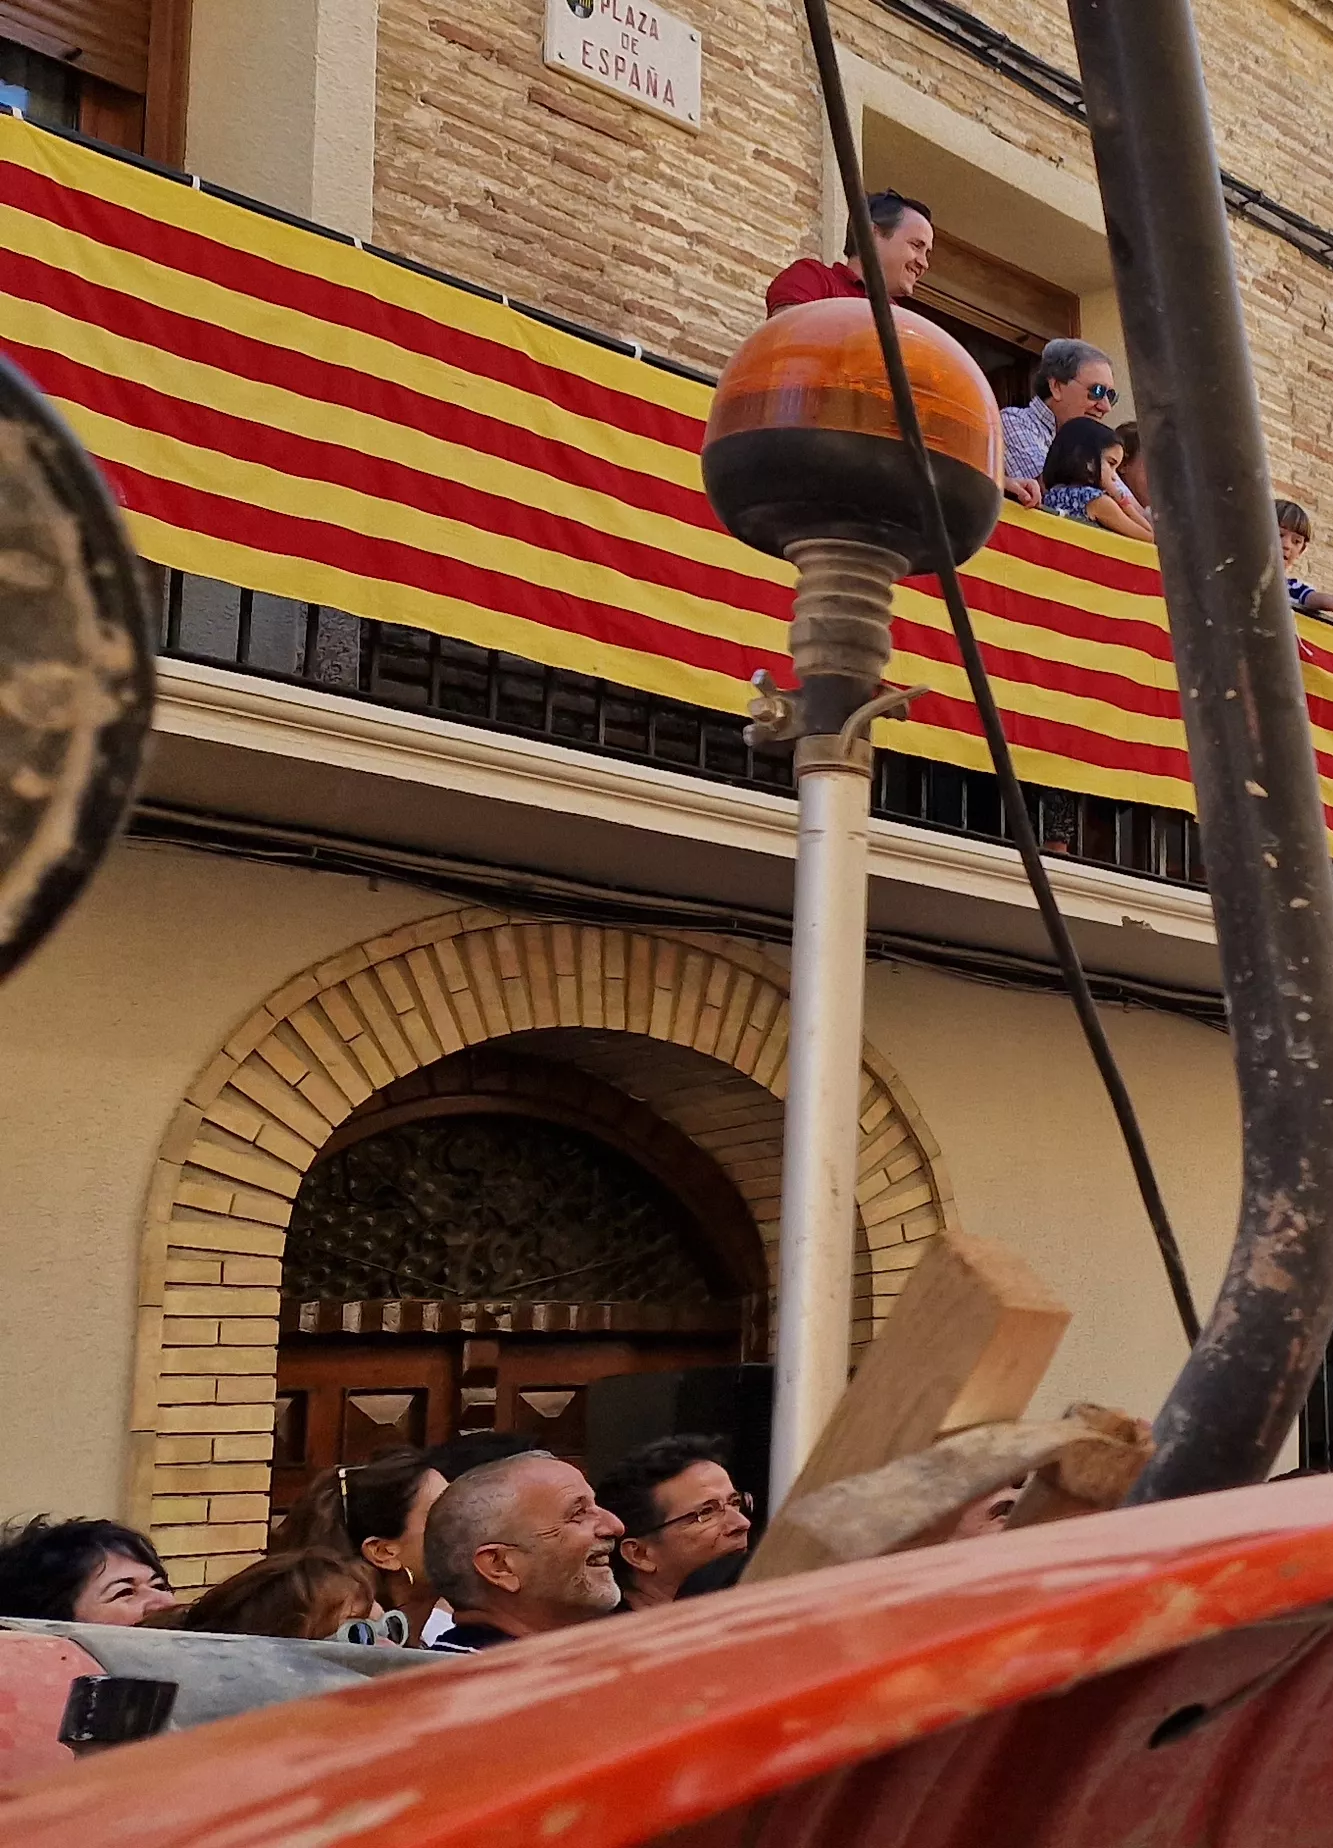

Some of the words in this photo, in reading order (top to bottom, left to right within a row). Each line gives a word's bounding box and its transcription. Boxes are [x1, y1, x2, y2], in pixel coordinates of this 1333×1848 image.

[600, 0, 660, 41] PLAZA
[621, 33, 639, 56] DE
[581, 39, 676, 108] ESPAÑA
